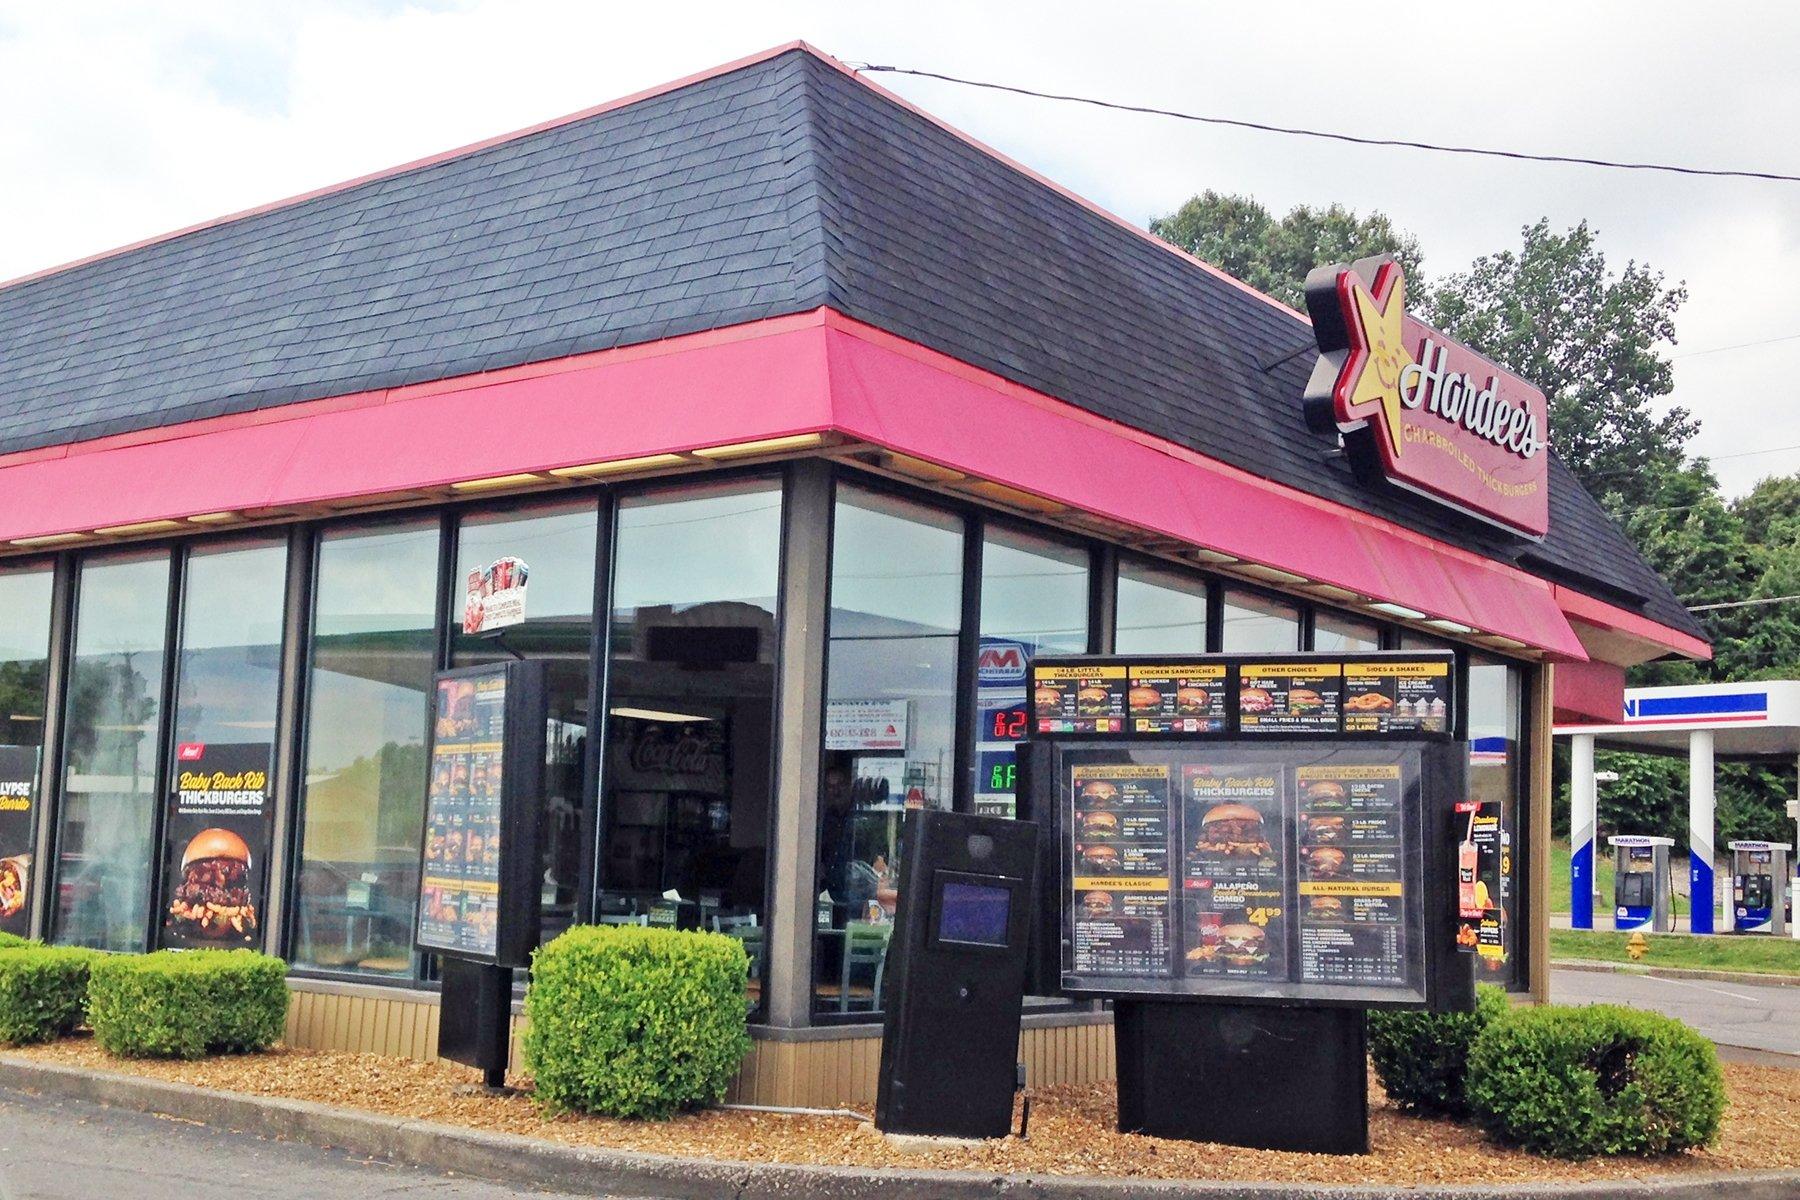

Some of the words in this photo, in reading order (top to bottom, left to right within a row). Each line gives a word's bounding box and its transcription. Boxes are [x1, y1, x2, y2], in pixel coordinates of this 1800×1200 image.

[1400, 338, 1551, 459] Hardee's
[1404, 423, 1476, 473] CHARBROILED
[1476, 464, 1538, 497] THICKBURGERS
[179, 771, 211, 792] Baby
[212, 771, 244, 790] Back
[243, 771, 266, 790] Rib
[1192, 777, 1223, 789] Baby
[1224, 776, 1254, 788] Back
[1253, 776, 1275, 788] Rib
[178, 790, 264, 805] THICKBURGERS
[1192, 787, 1275, 796] THICKBURGERS
[1213, 881, 1259, 890] JALAPEÑO
[1213, 895, 1246, 903] COMBO
